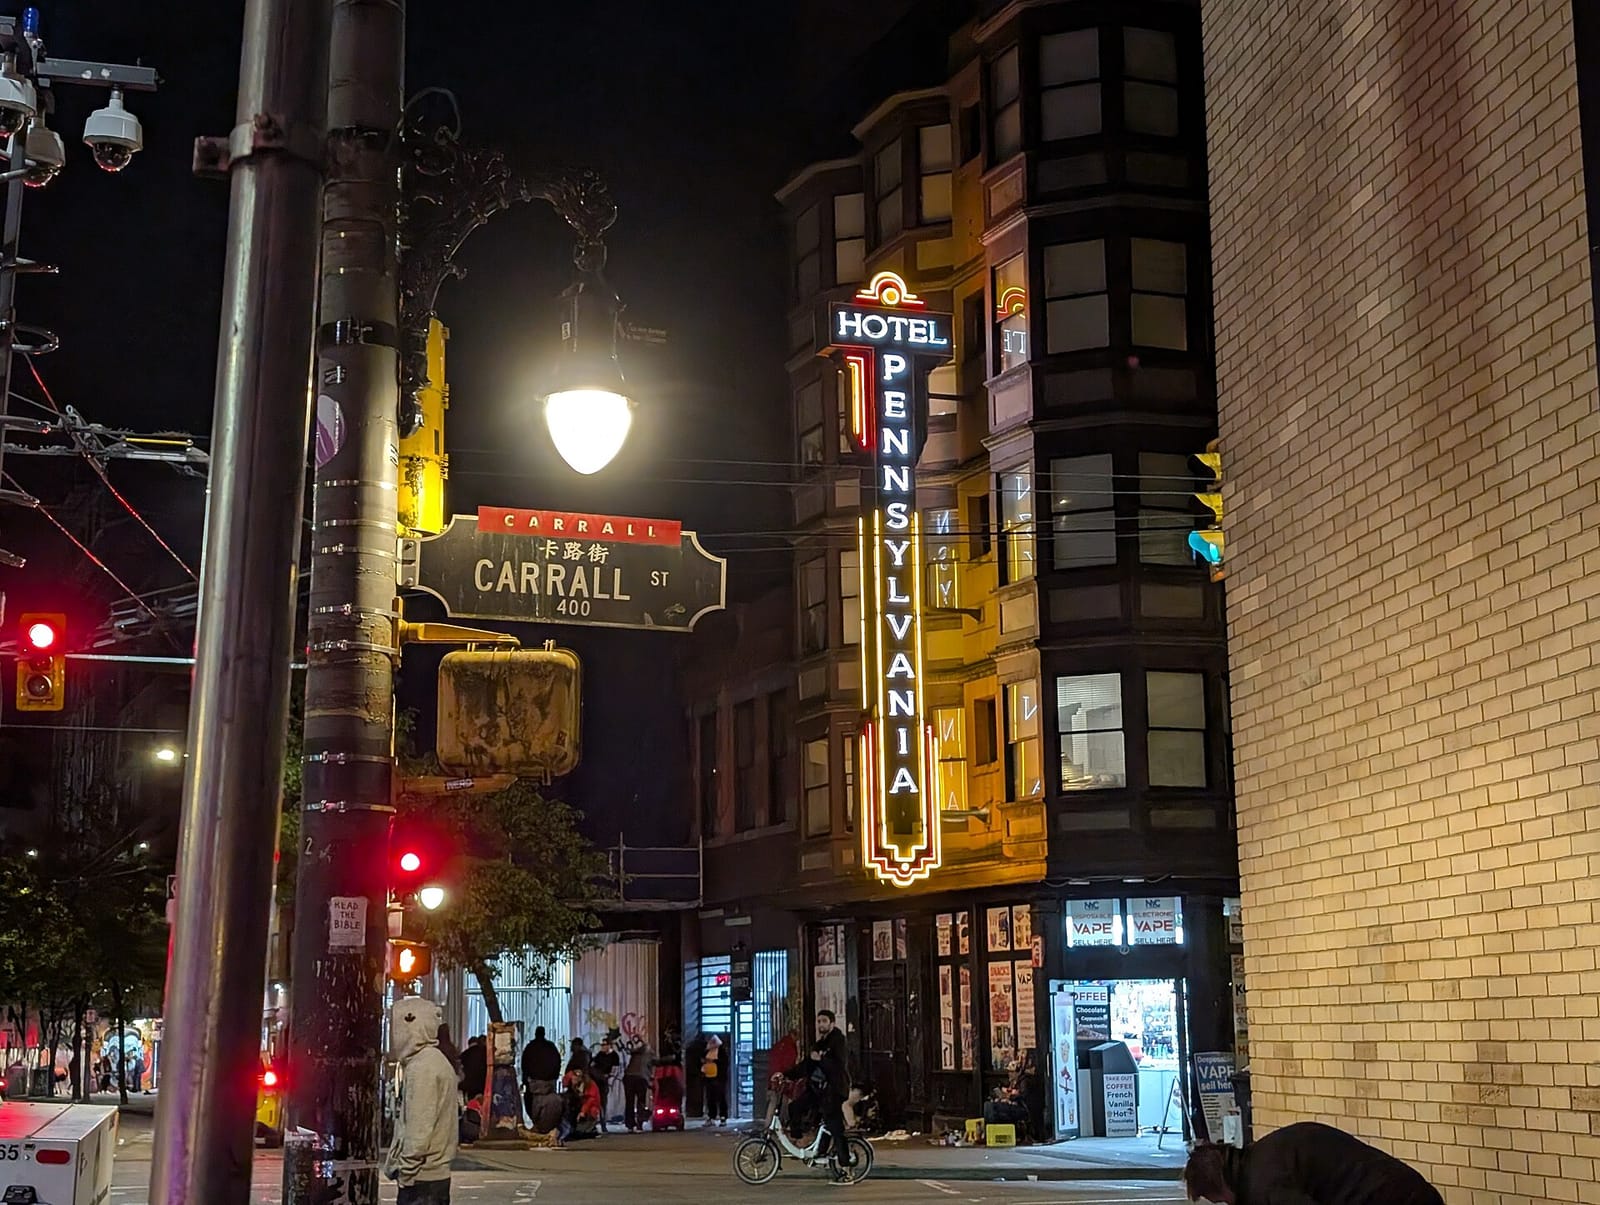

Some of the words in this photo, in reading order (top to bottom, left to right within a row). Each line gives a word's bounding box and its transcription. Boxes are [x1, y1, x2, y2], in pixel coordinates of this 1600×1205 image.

[838, 311, 947, 345] HOTEL
[503, 514, 657, 538] CARRALL
[539, 539, 609, 565] 卡路街
[474, 558, 631, 601] CARRALL
[650, 570, 670, 587] ST
[883, 354, 919, 795] PENNSYLVANIA
[556, 599, 591, 617] 400
[334, 901, 359, 910] READ
[340, 911, 356, 919] THE
[334, 919, 361, 930] BIBLE
[1073, 922, 1112, 935] VAPE
[1134, 920, 1174, 933] VAPE
[1135, 937, 1154, 945] SELL
[1073, 991, 1107, 1001] OFFEE
[1076, 1006, 1107, 1014] Chocolate
[1201, 1080, 1216, 1091] sell
[1218, 1079, 1234, 1090] her
[1107, 1091, 1133, 1099] French
[1113, 1110, 1127, 1118] Hot
